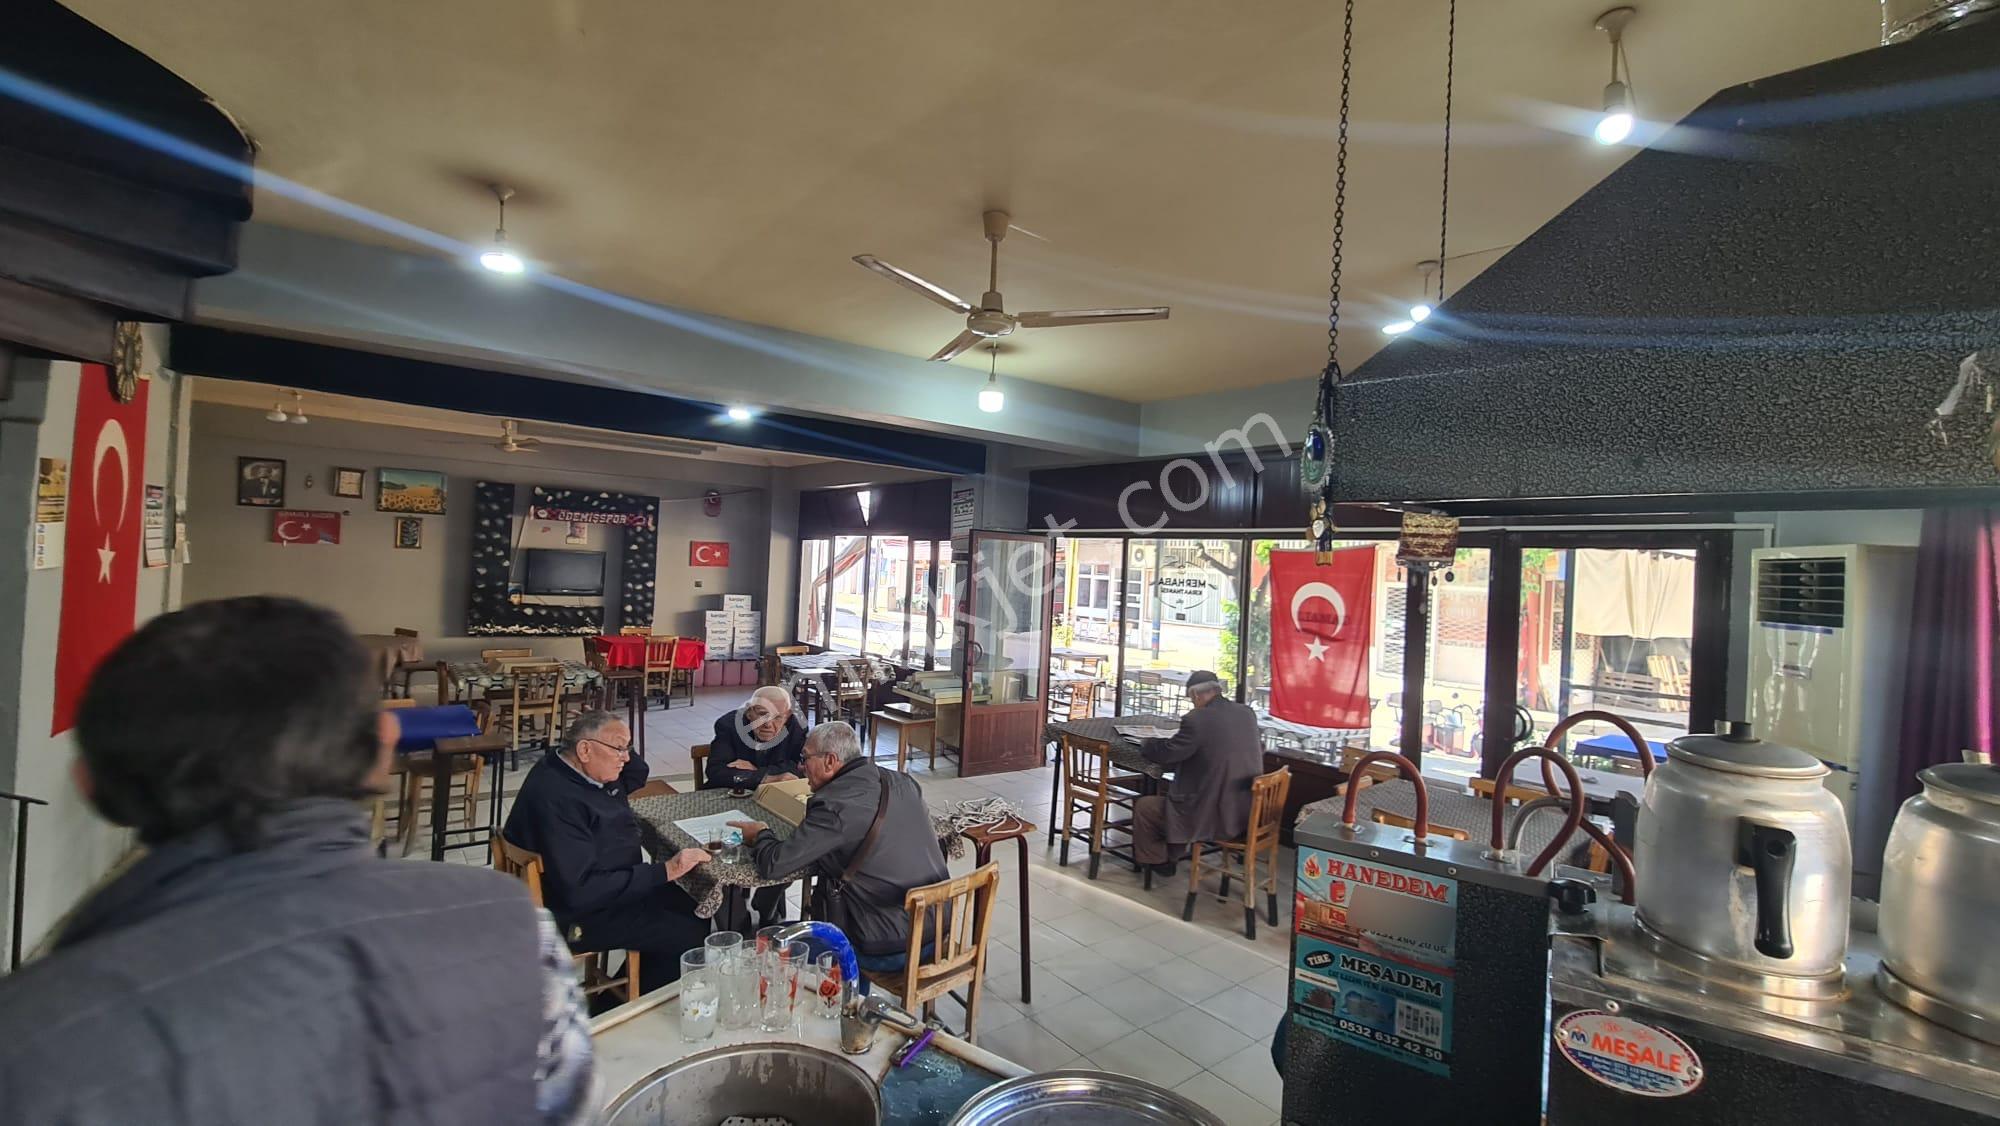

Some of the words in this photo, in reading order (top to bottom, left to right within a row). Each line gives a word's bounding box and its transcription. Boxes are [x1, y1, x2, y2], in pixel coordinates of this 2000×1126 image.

[1326, 858, 1449, 903] HANEDEM
[1340, 954, 1443, 998] MEŞADEM
[1339, 1019, 1372, 1038] 0532
[1374, 1031, 1399, 1047] 632
[1402, 1041, 1421, 1054] 42
[1425, 1048, 1443, 1061] 50
[1591, 1033, 1682, 1073] MEŞALE
